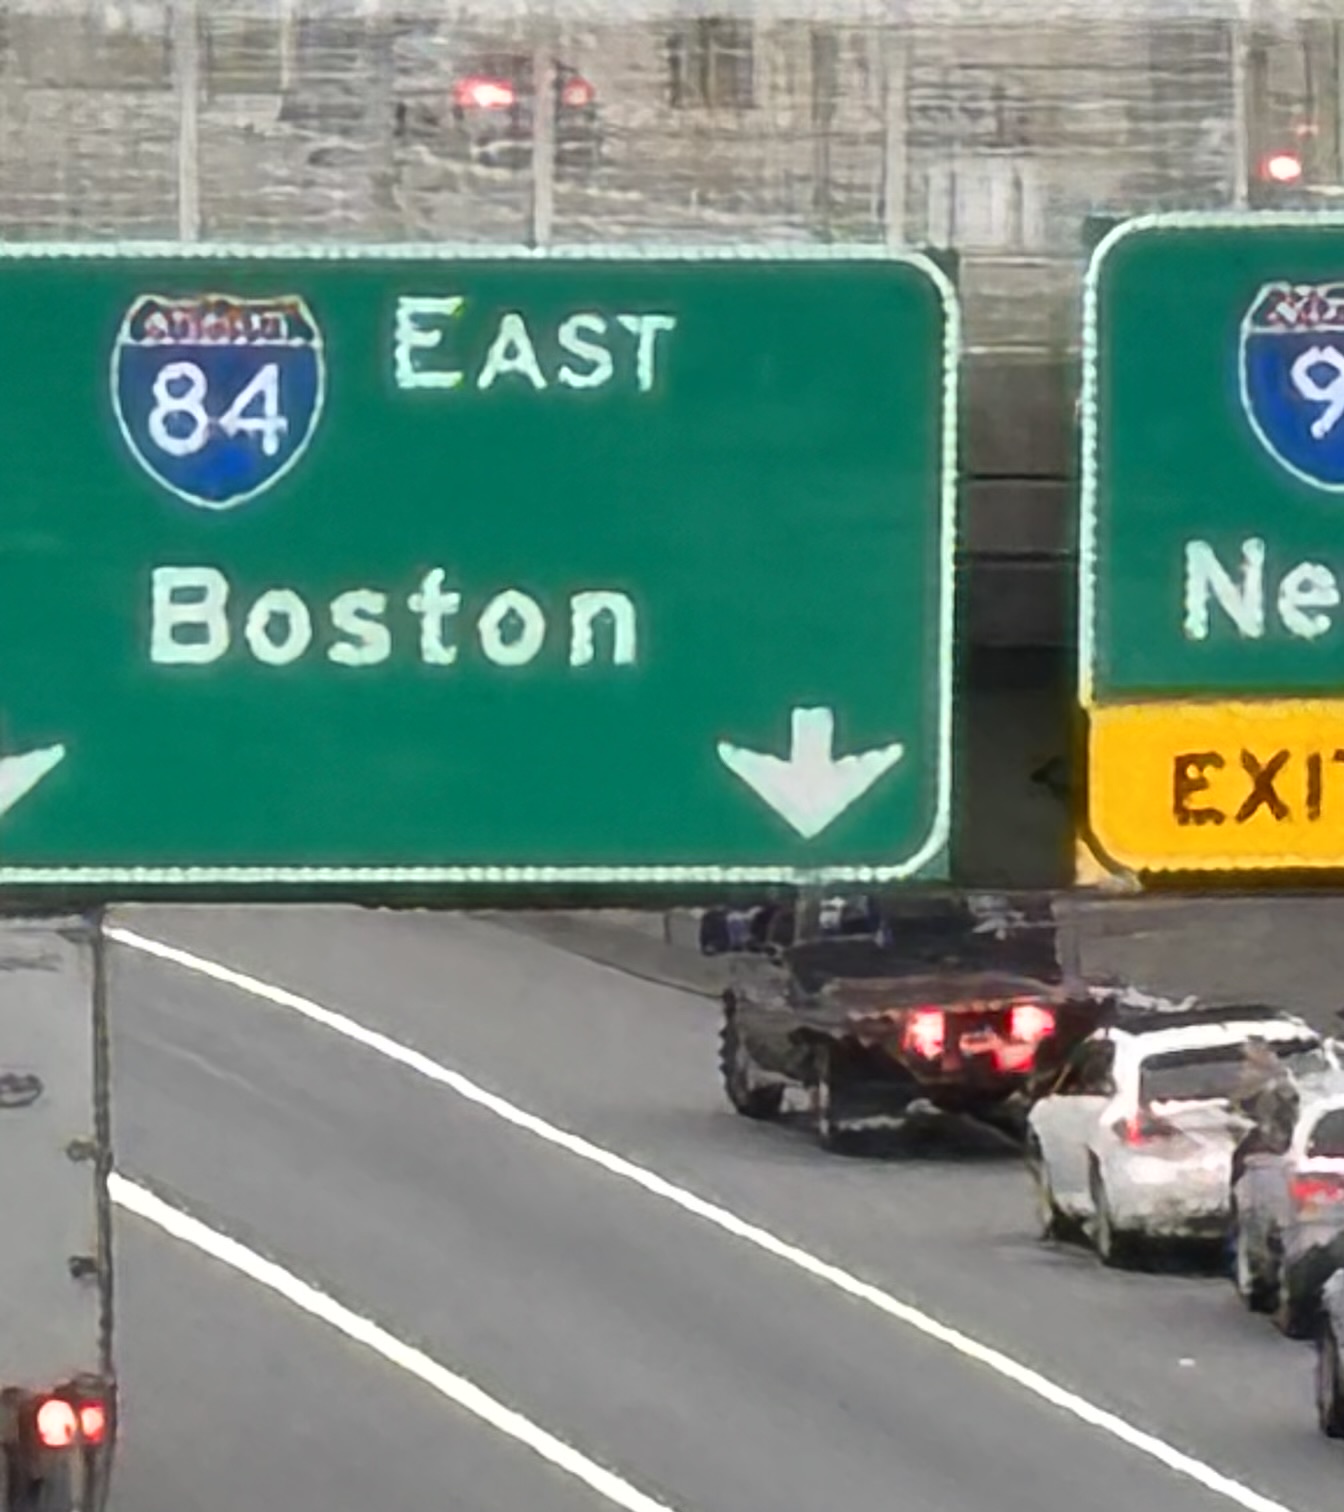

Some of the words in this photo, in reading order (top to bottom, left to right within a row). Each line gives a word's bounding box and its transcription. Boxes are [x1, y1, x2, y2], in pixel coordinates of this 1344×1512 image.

[394, 296, 676, 391] EAST
[148, 361, 288, 457] 84
[150, 566, 637, 666] Boston
